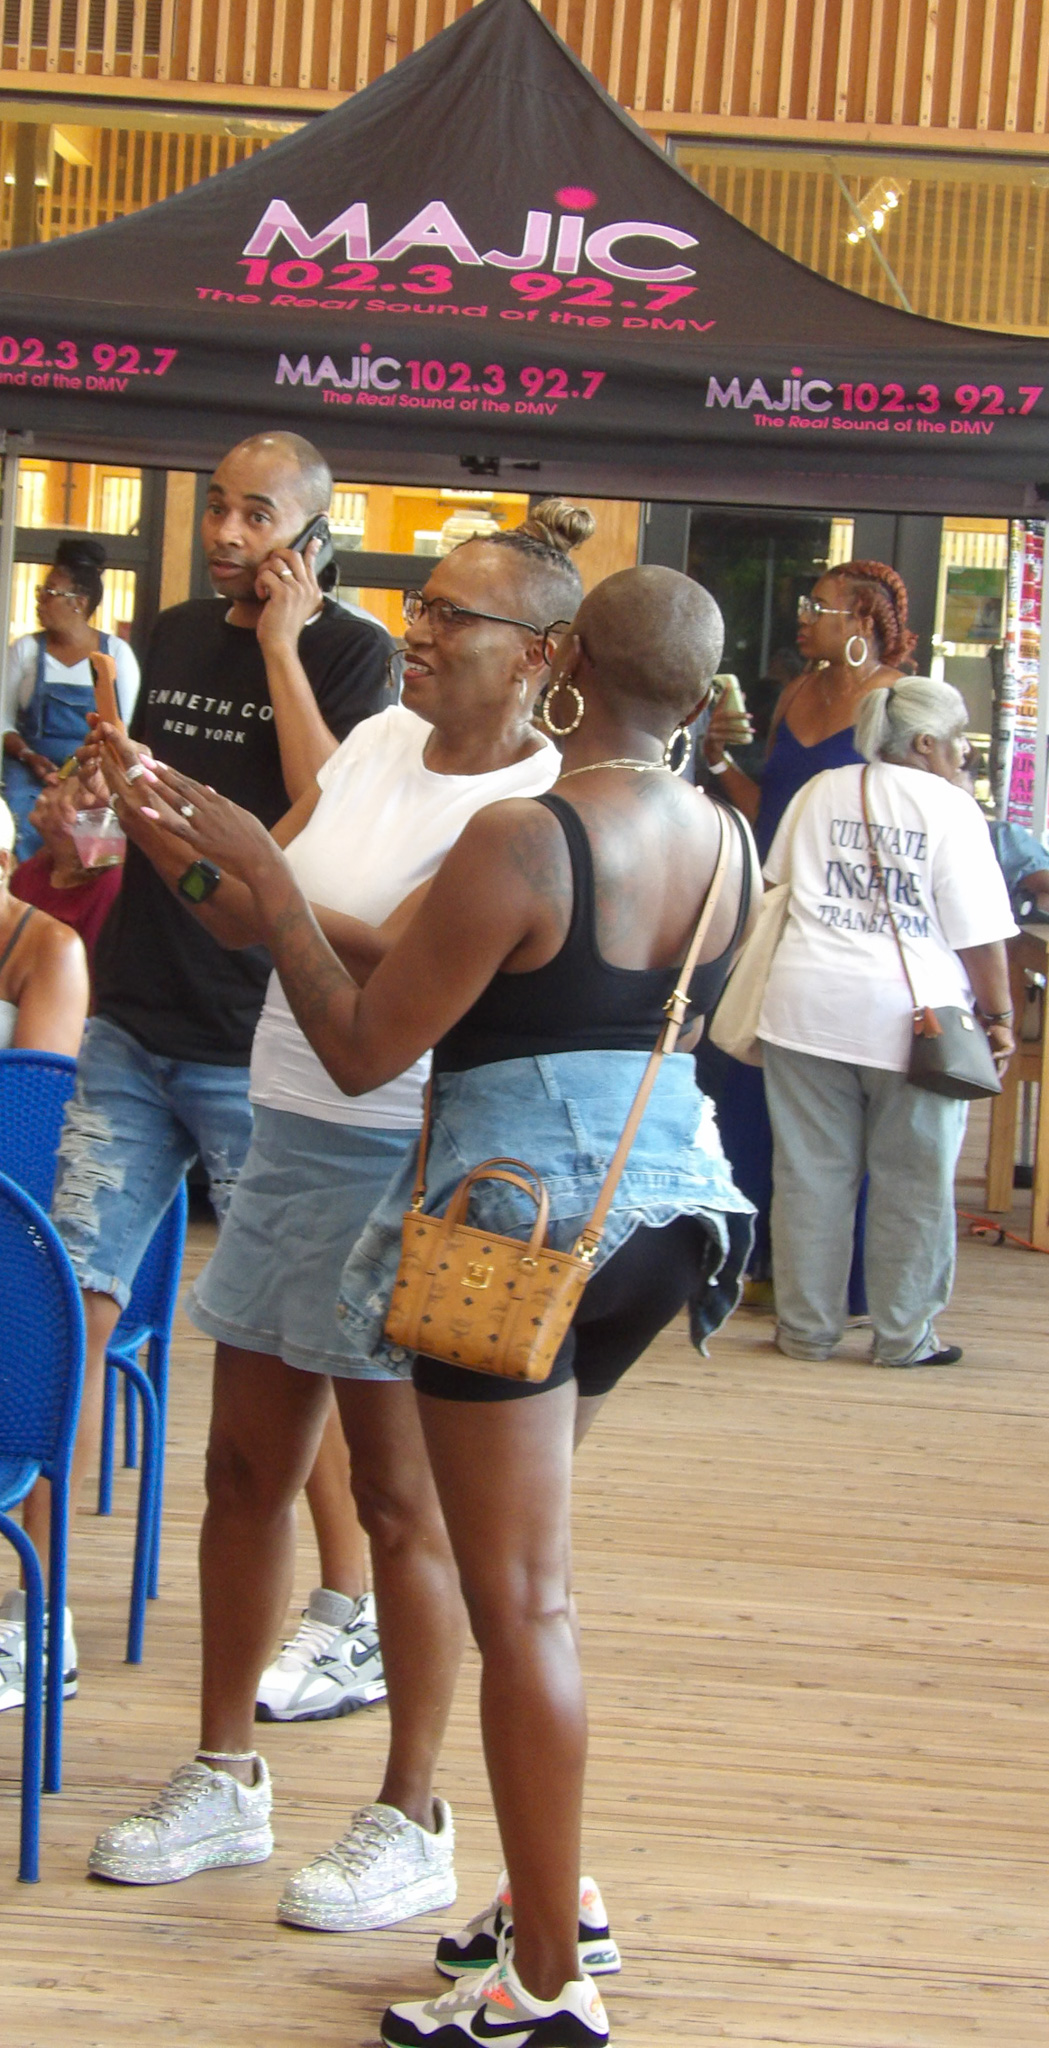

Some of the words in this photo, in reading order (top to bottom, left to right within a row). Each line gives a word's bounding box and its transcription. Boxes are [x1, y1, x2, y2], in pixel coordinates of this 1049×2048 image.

[236, 259, 453, 294] 102.3
[510, 272, 698, 311] 92.7
[195, 287, 261, 304] The
[270, 294, 359, 310] Real
[365, 299, 488, 317] Sound
[500, 309, 540, 321] of
[549, 311, 611, 328] the
[622, 317, 716, 332] DMV
[0, 336, 79, 370] 02.3
[92, 343, 178, 376] 92.7
[31, 372, 49, 387] of
[53, 373, 82, 389] the
[86, 375, 129, 391] DMV
[405, 360, 507, 395] 102.3
[519, 366, 606, 399] 92.7
[322, 389, 353, 404] The
[356, 391, 397, 406] Real
[399, 394, 454, 409] Sound
[459, 398, 478, 411] of
[482, 399, 511, 412] the
[515, 401, 557, 415] DMV
[837, 383, 940, 414] 102.3
[954, 385, 1043, 415] 92.7
[753, 414, 784, 428] The
[788, 415, 828, 429] Real
[832, 418, 889, 431] Sound
[894, 419, 913, 432] of
[916, 419, 946, 433] the
[951, 420, 994, 435] DMV
[148, 689, 233, 715] ENNETH
[241, 703, 274, 721] CO
[163, 719, 198, 737] NEW
[204, 728, 246, 744] YORK
[817, 905, 930, 938] TRANSFRM
